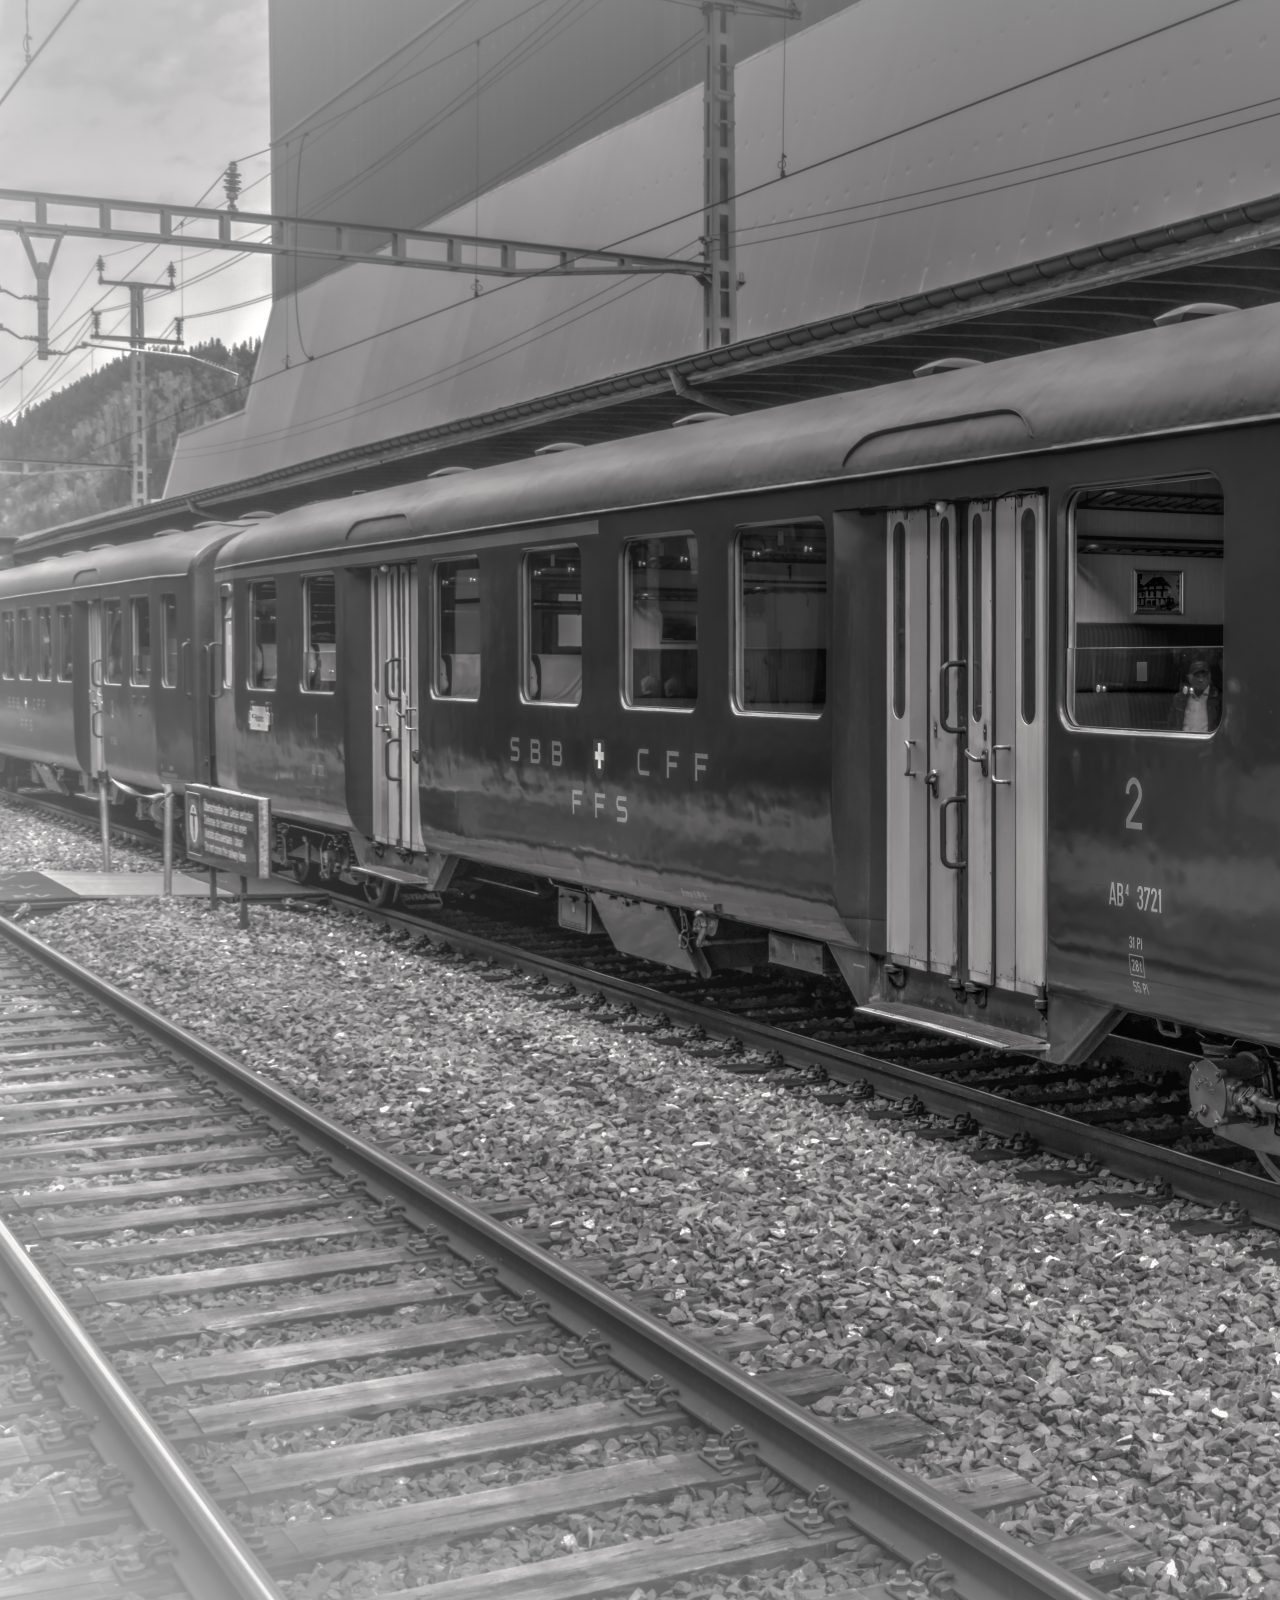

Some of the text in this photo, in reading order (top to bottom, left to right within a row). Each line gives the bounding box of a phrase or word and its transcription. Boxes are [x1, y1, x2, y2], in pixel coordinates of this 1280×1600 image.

[510, 736, 709, 782] SBB CFF
[571, 789, 628, 823] FFS
[1125, 777, 1143, 830] 2
[1136, 885, 1162, 914] 3721
